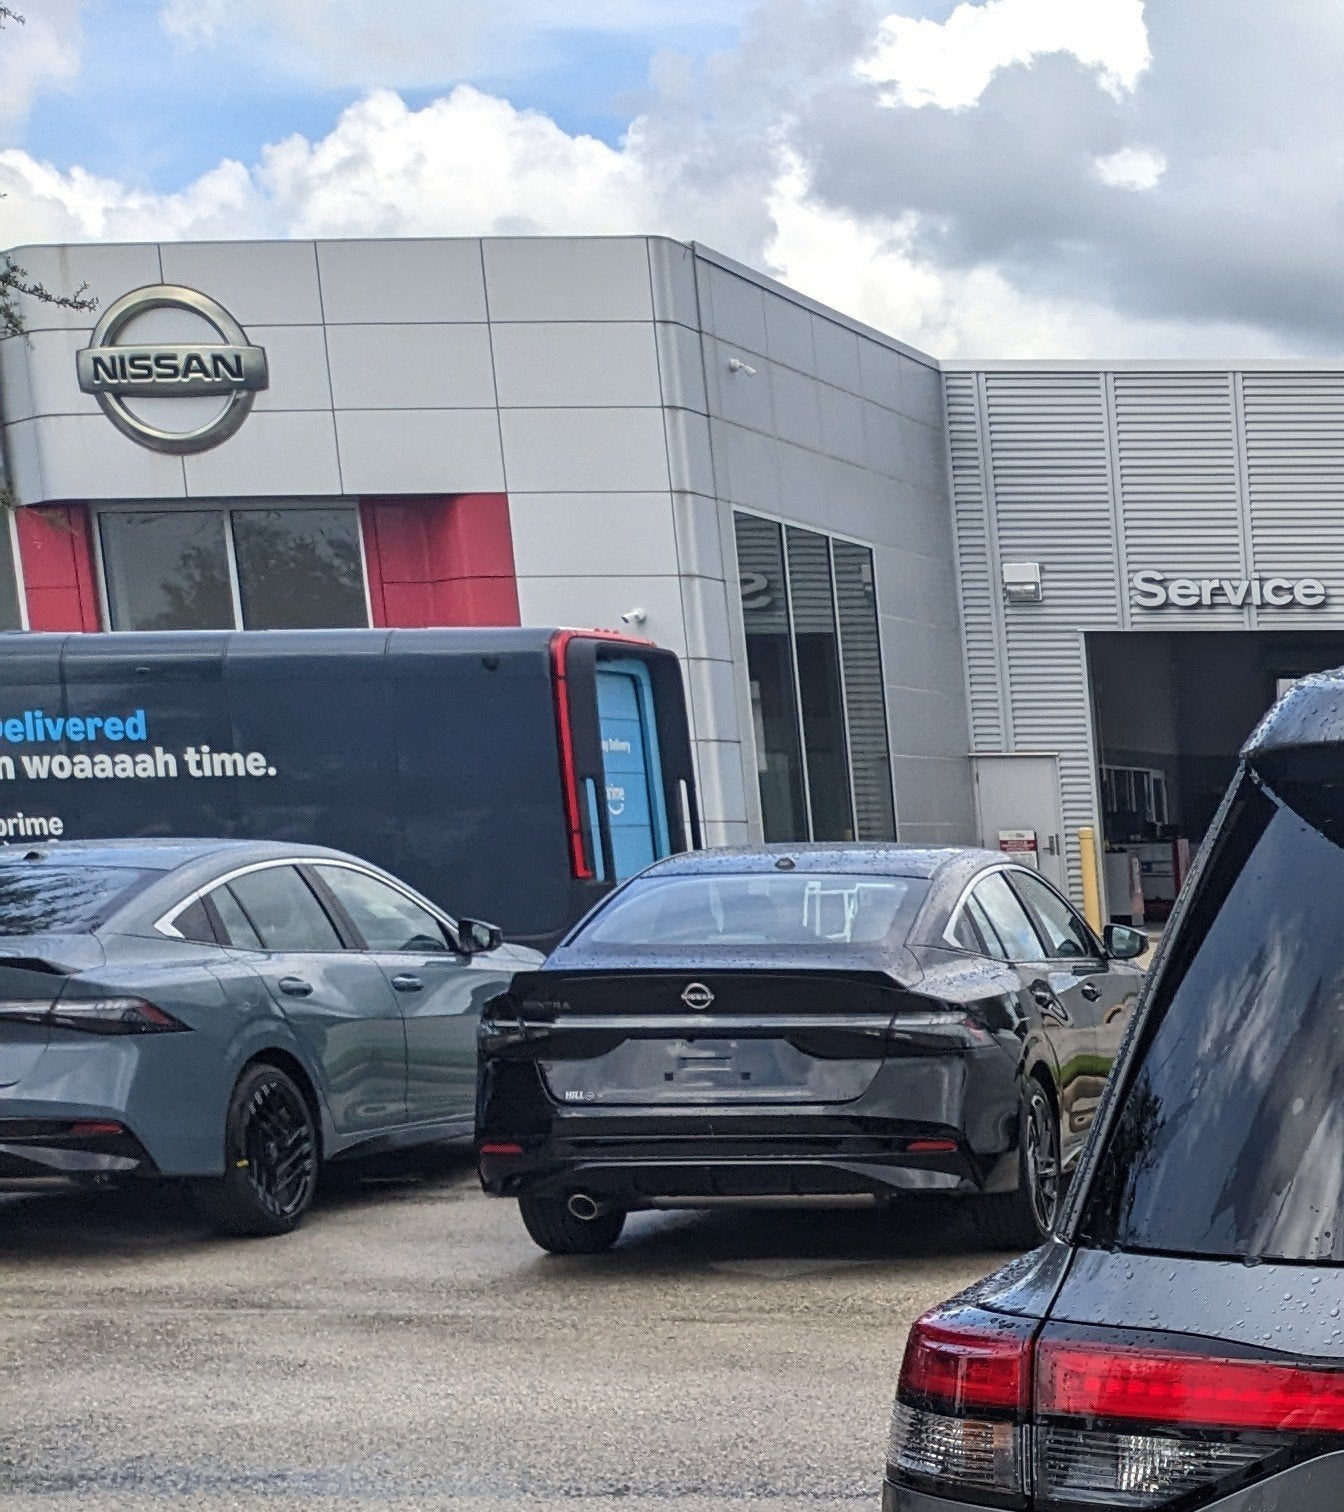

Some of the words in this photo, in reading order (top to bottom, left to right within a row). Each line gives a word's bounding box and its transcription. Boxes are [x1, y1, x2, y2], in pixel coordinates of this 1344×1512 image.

[91, 353, 245, 384] NISSAN
[1132, 570, 1326, 607] Service
[0, 710, 147, 742] elivered
[21, 746, 178, 780] woaaaah
[185, 745, 278, 778] time.
